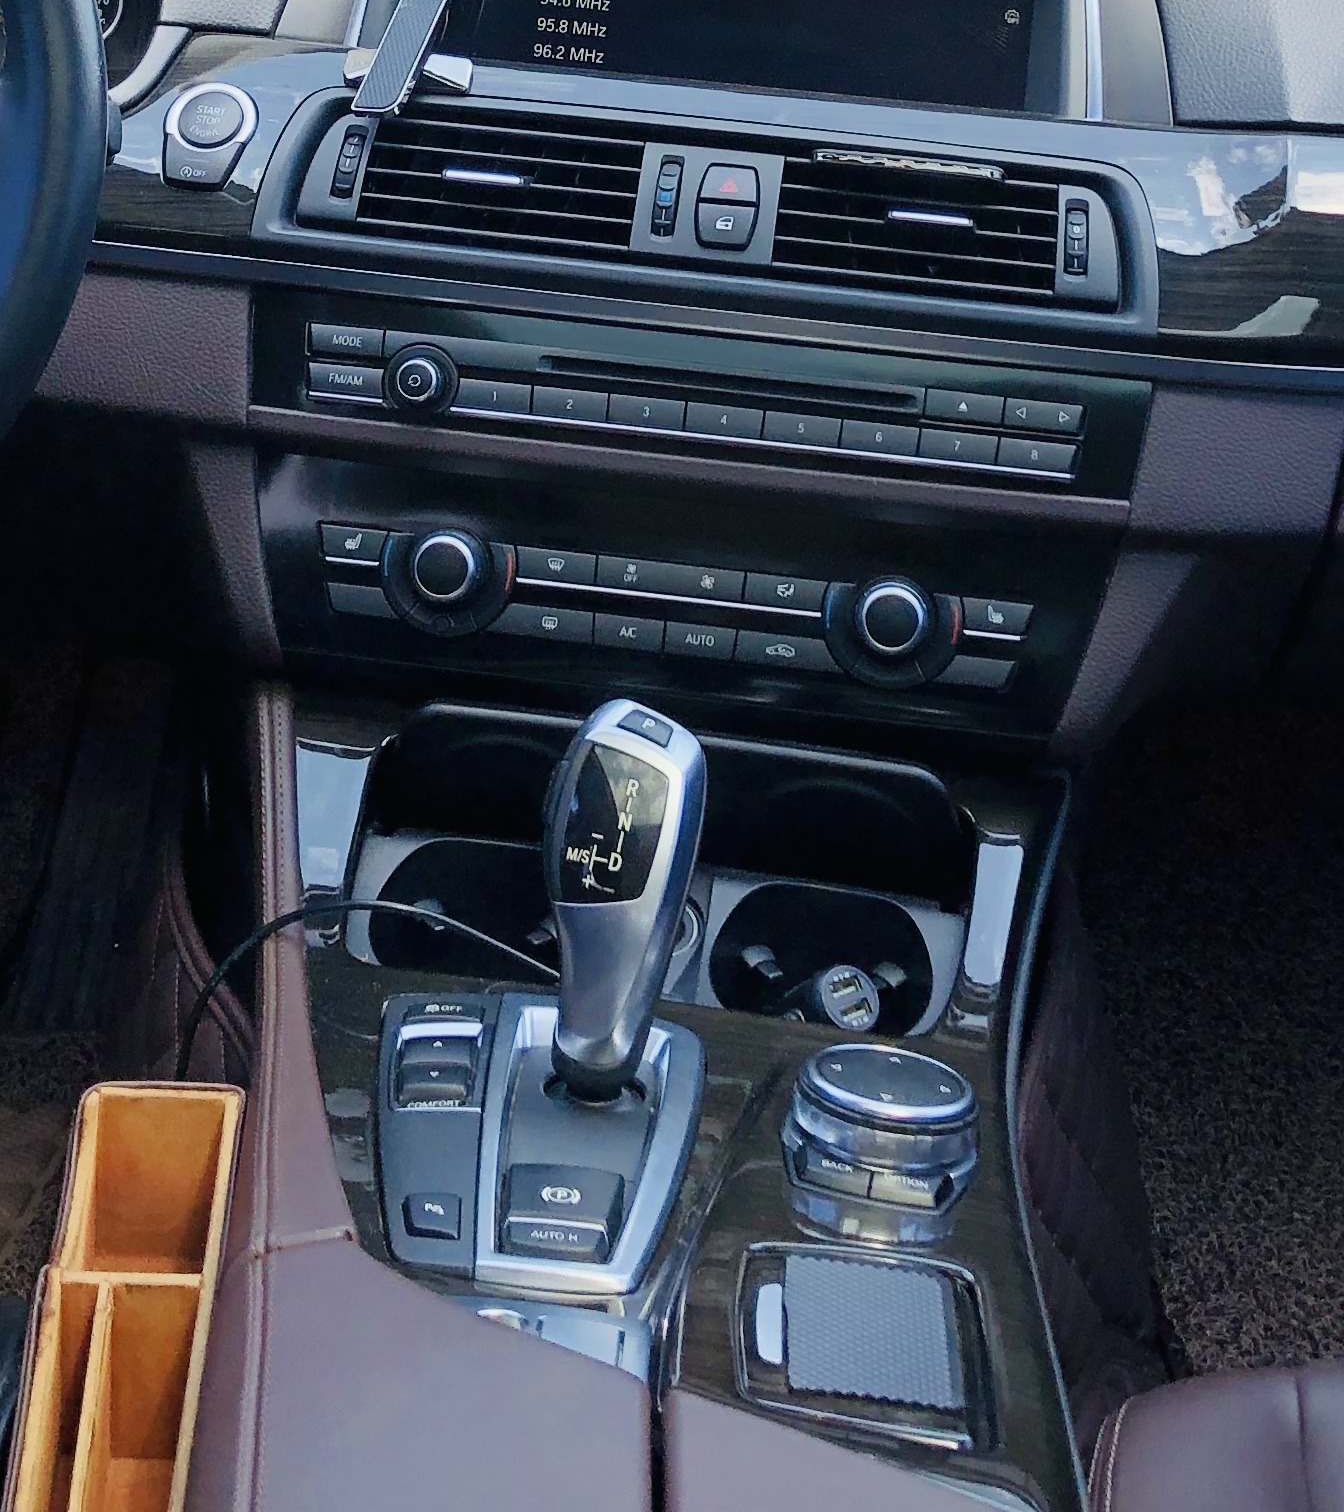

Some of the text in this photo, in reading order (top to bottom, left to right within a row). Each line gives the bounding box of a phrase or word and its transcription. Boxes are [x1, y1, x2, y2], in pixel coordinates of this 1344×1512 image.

[537, 17, 607, 37] 95.8 MHz
[533, 43, 605, 64] 96.2 MHz
[196, 104, 226, 116] START
[195, 114, 221, 125] STOP
[189, 125, 220, 138] ENGINE
[192, 169, 207, 178] OFF
[332, 334, 363, 348] MODE
[328, 372, 363, 386] FM/AM
[566, 399, 573, 410] 2
[642, 406, 650, 417] 3
[720, 414, 727, 425] 4
[797, 422, 804, 434] 5
[875, 431, 882, 443] 6
[954, 440, 961, 451] 7
[1030, 448, 1039, 460] 8
[623, 573, 638, 583] OFF
[619, 625, 636, 638] A/C
[685, 632, 715, 647] AUTO
[642, 718, 656, 729] P
[626, 778, 640, 798] R
[618, 811, 633, 832] N
[566, 846, 591, 864] M/S
[608, 852, 623, 872] D
[821, 1158, 853, 1173] BACK
[530, 1229, 578, 1242] AUTO H
